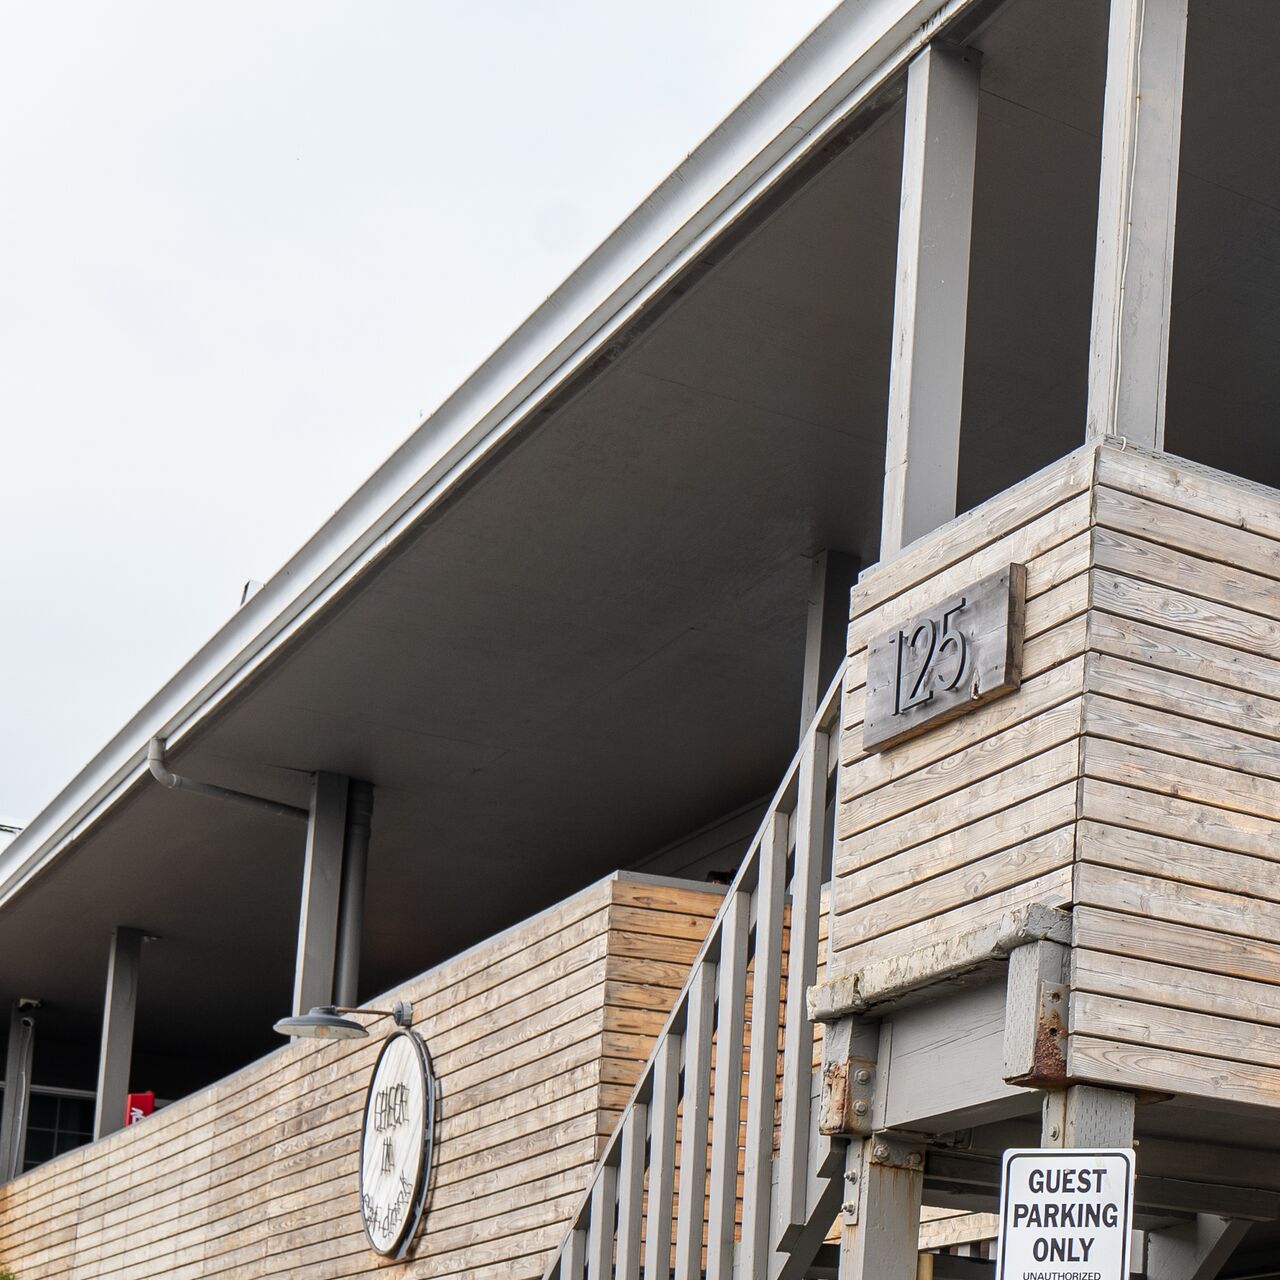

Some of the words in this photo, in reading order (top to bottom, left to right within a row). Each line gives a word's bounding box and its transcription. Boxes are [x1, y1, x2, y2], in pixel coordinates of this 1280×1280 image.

[889, 597, 966, 716] 125
[374, 1082, 410, 1133] CHECK
[1028, 1169, 1107, 1194] GUEST
[1013, 1203, 1118, 1228] PARKING
[1032, 1237, 1095, 1262] ONLY
[1023, 1272, 1101, 1280] UNAUTHORIZED
